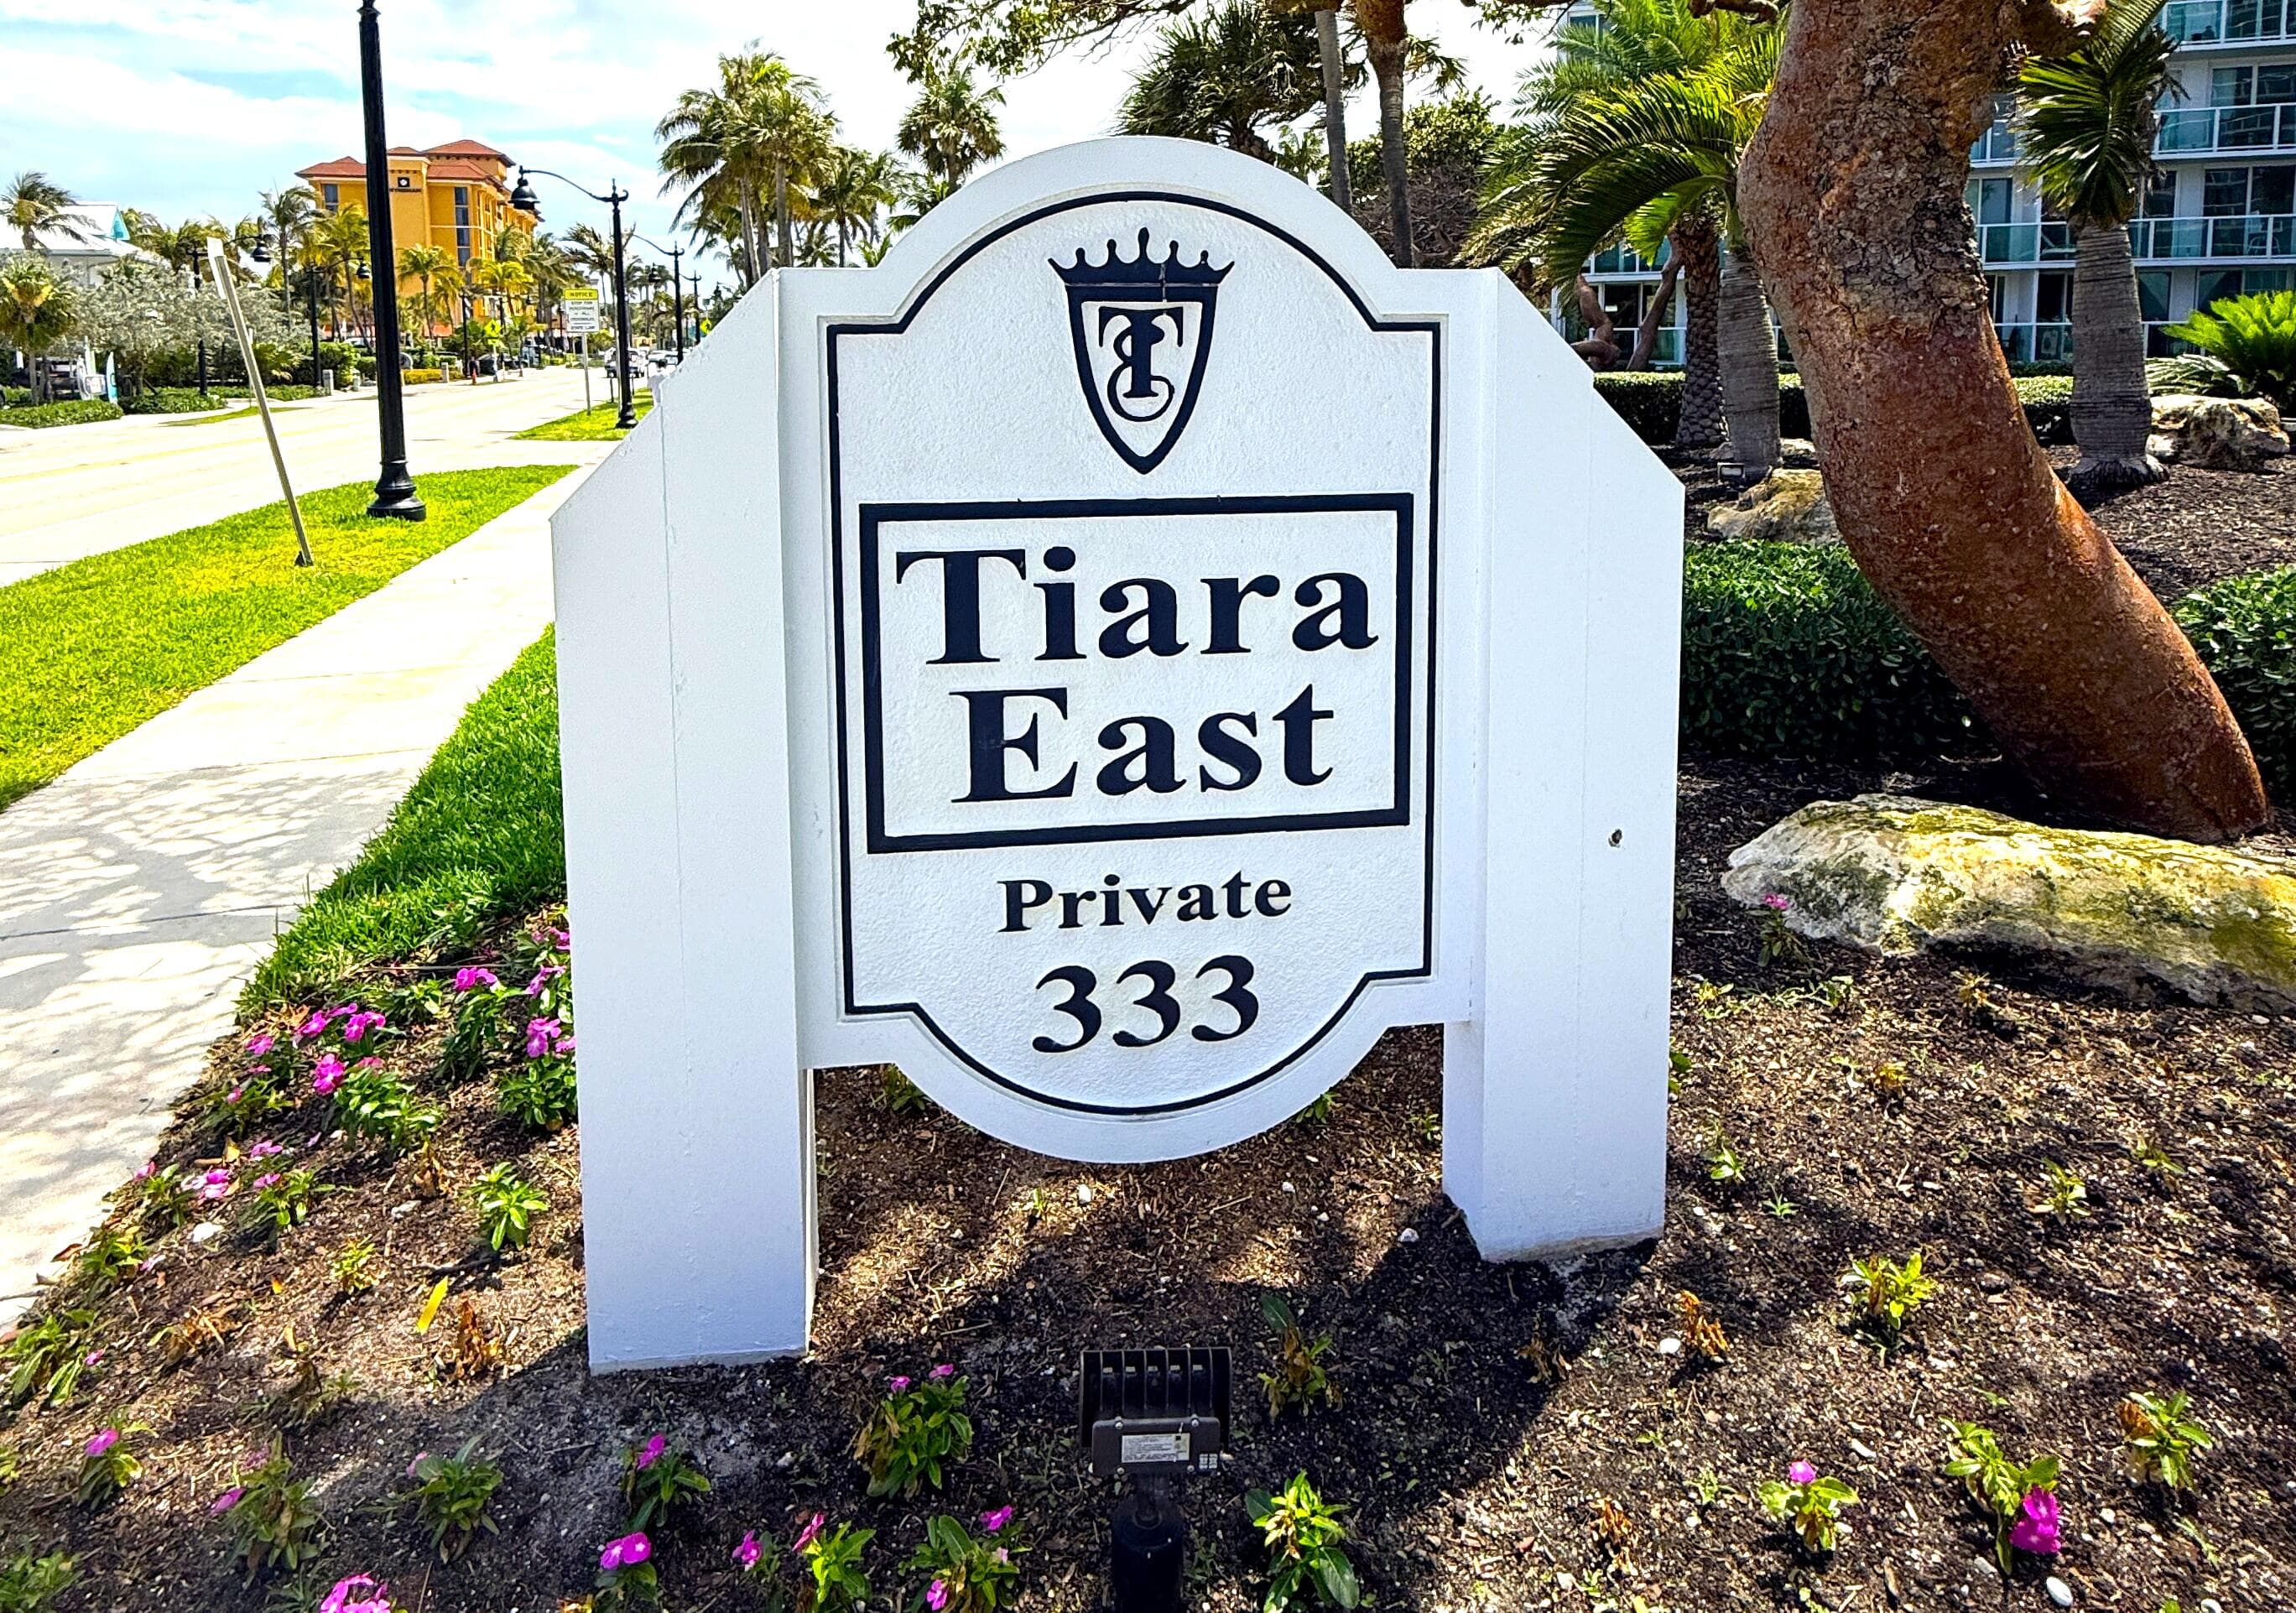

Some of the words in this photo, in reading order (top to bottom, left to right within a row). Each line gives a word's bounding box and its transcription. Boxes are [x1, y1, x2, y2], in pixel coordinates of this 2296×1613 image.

[896, 546, 1379, 665] Tiara
[948, 684, 1334, 804] East
[997, 870, 1292, 933] Private
[1032, 955, 1259, 1054] 333
